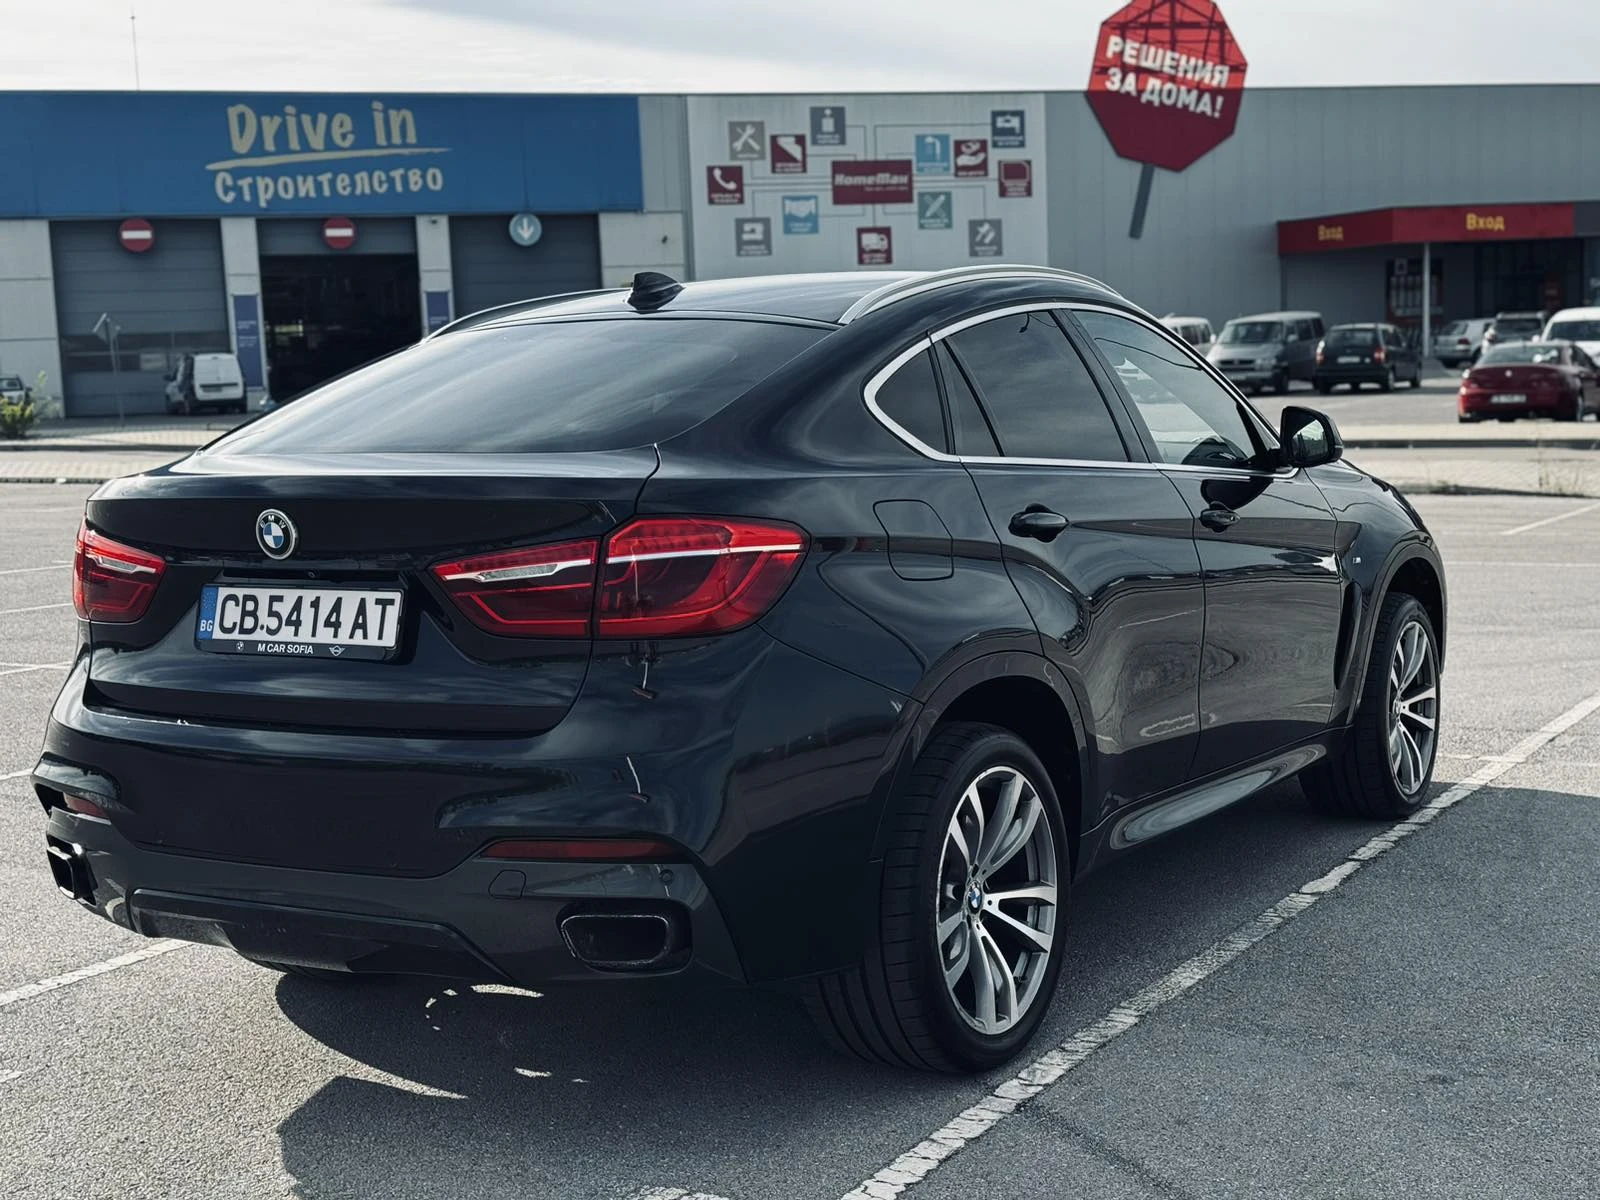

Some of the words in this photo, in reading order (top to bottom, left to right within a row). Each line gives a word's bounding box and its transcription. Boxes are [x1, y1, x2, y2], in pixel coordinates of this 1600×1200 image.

[1105, 35, 1230, 88] РЕШЕНИЯ
[1105, 67, 1138, 97] ЗА
[1141, 77, 1223, 118] ДОМА!
[227, 103, 355, 154] Drive
[371, 100, 417, 145] in
[215, 167, 444, 208] Строителство
[1466, 213, 1505, 231] Вход
[200, 619, 213, 632] BG
[257, 643, 266, 652] M
[266, 644, 286, 653] CAR
[287, 645, 314, 655] SOFIA
